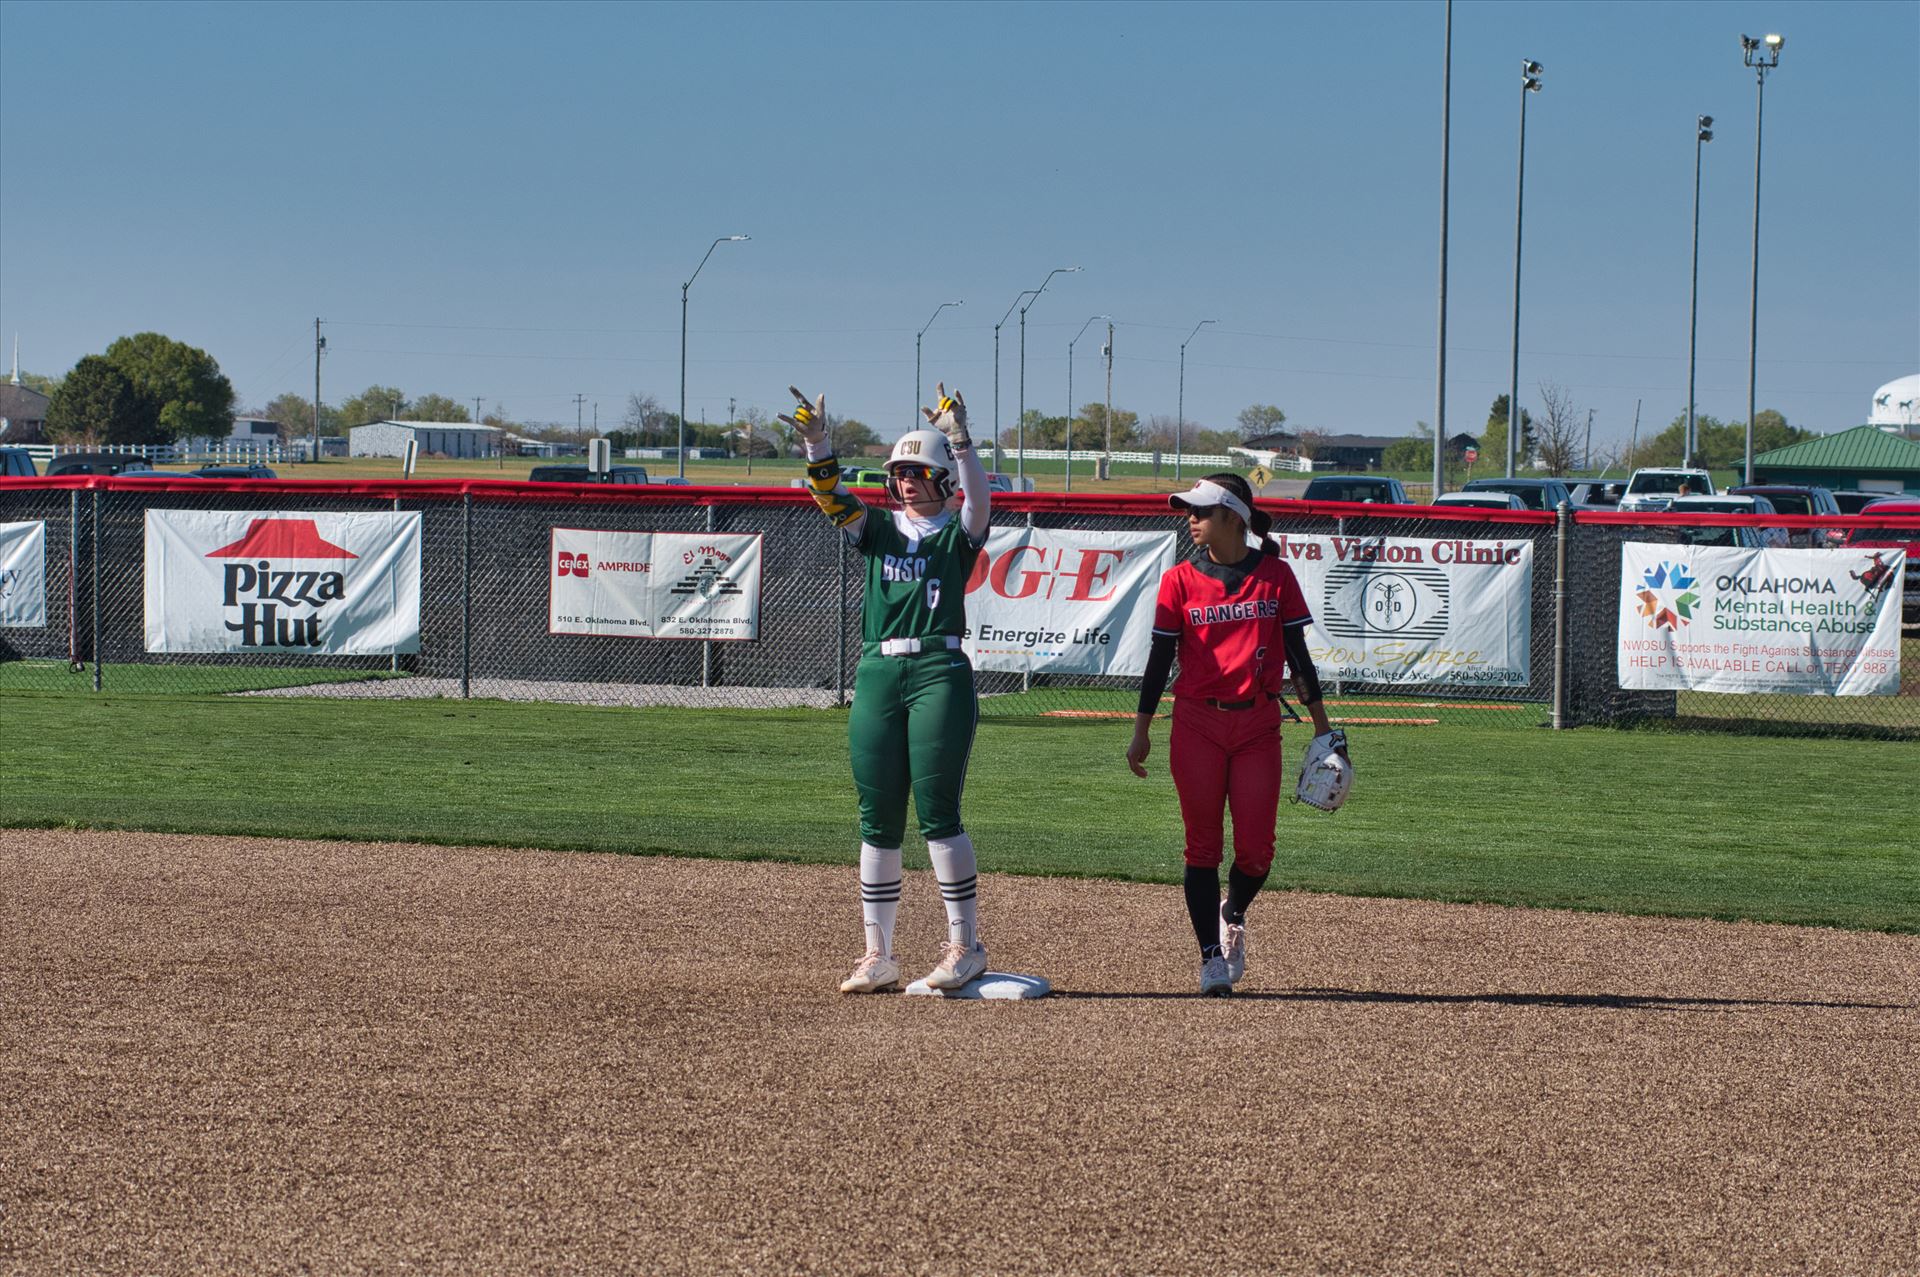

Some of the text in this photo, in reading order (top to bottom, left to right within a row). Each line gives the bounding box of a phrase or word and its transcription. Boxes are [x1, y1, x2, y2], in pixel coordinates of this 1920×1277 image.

[1279, 535, 1521, 565] lva Vision Clinic
[559, 559, 589, 569] CENEX
[597, 562, 650, 573] AMPRIDE
[882, 554, 931, 581] BISO
[223, 560, 345, 607] Pizza
[1716, 575, 1836, 595] OKLAHOMA
[1188, 599, 1279, 625] RANGERS
[1716, 598, 1877, 616] Mental Health &
[225, 603, 321, 647] Hut
[585, 617, 627, 625] Oklahoma
[629, 618, 650, 626] Blvd.
[660, 616, 677, 624] 832
[689, 616, 730, 624] Oklahoma
[732, 617, 753, 625] Blvd.
[1713, 615, 1876, 634] Substance Abuse
[979, 624, 1066, 648] Energize
[1072, 628, 1111, 645] Life
[1623, 640, 1667, 651] NWOSU
[1713, 643, 1729, 654] the
[1732, 643, 1758, 657] Fight
[1760, 645, 1799, 658] Against
[1802, 646, 1857, 658] Substance
[1338, 666, 1359, 678] 504
[1361, 667, 1404, 682] College
[1408, 670, 1433, 680] Ave.
[1630, 656, 1667, 668] HELP
[1672, 656, 1685, 668] IS
[1687, 658, 1760, 672] AVAILABLE
[1765, 660, 1803, 673] CALL
[1806, 664, 1819, 673] or
[1863, 662, 1887, 674] 988
[1450, 670, 1524, 682] 580-829-2026
